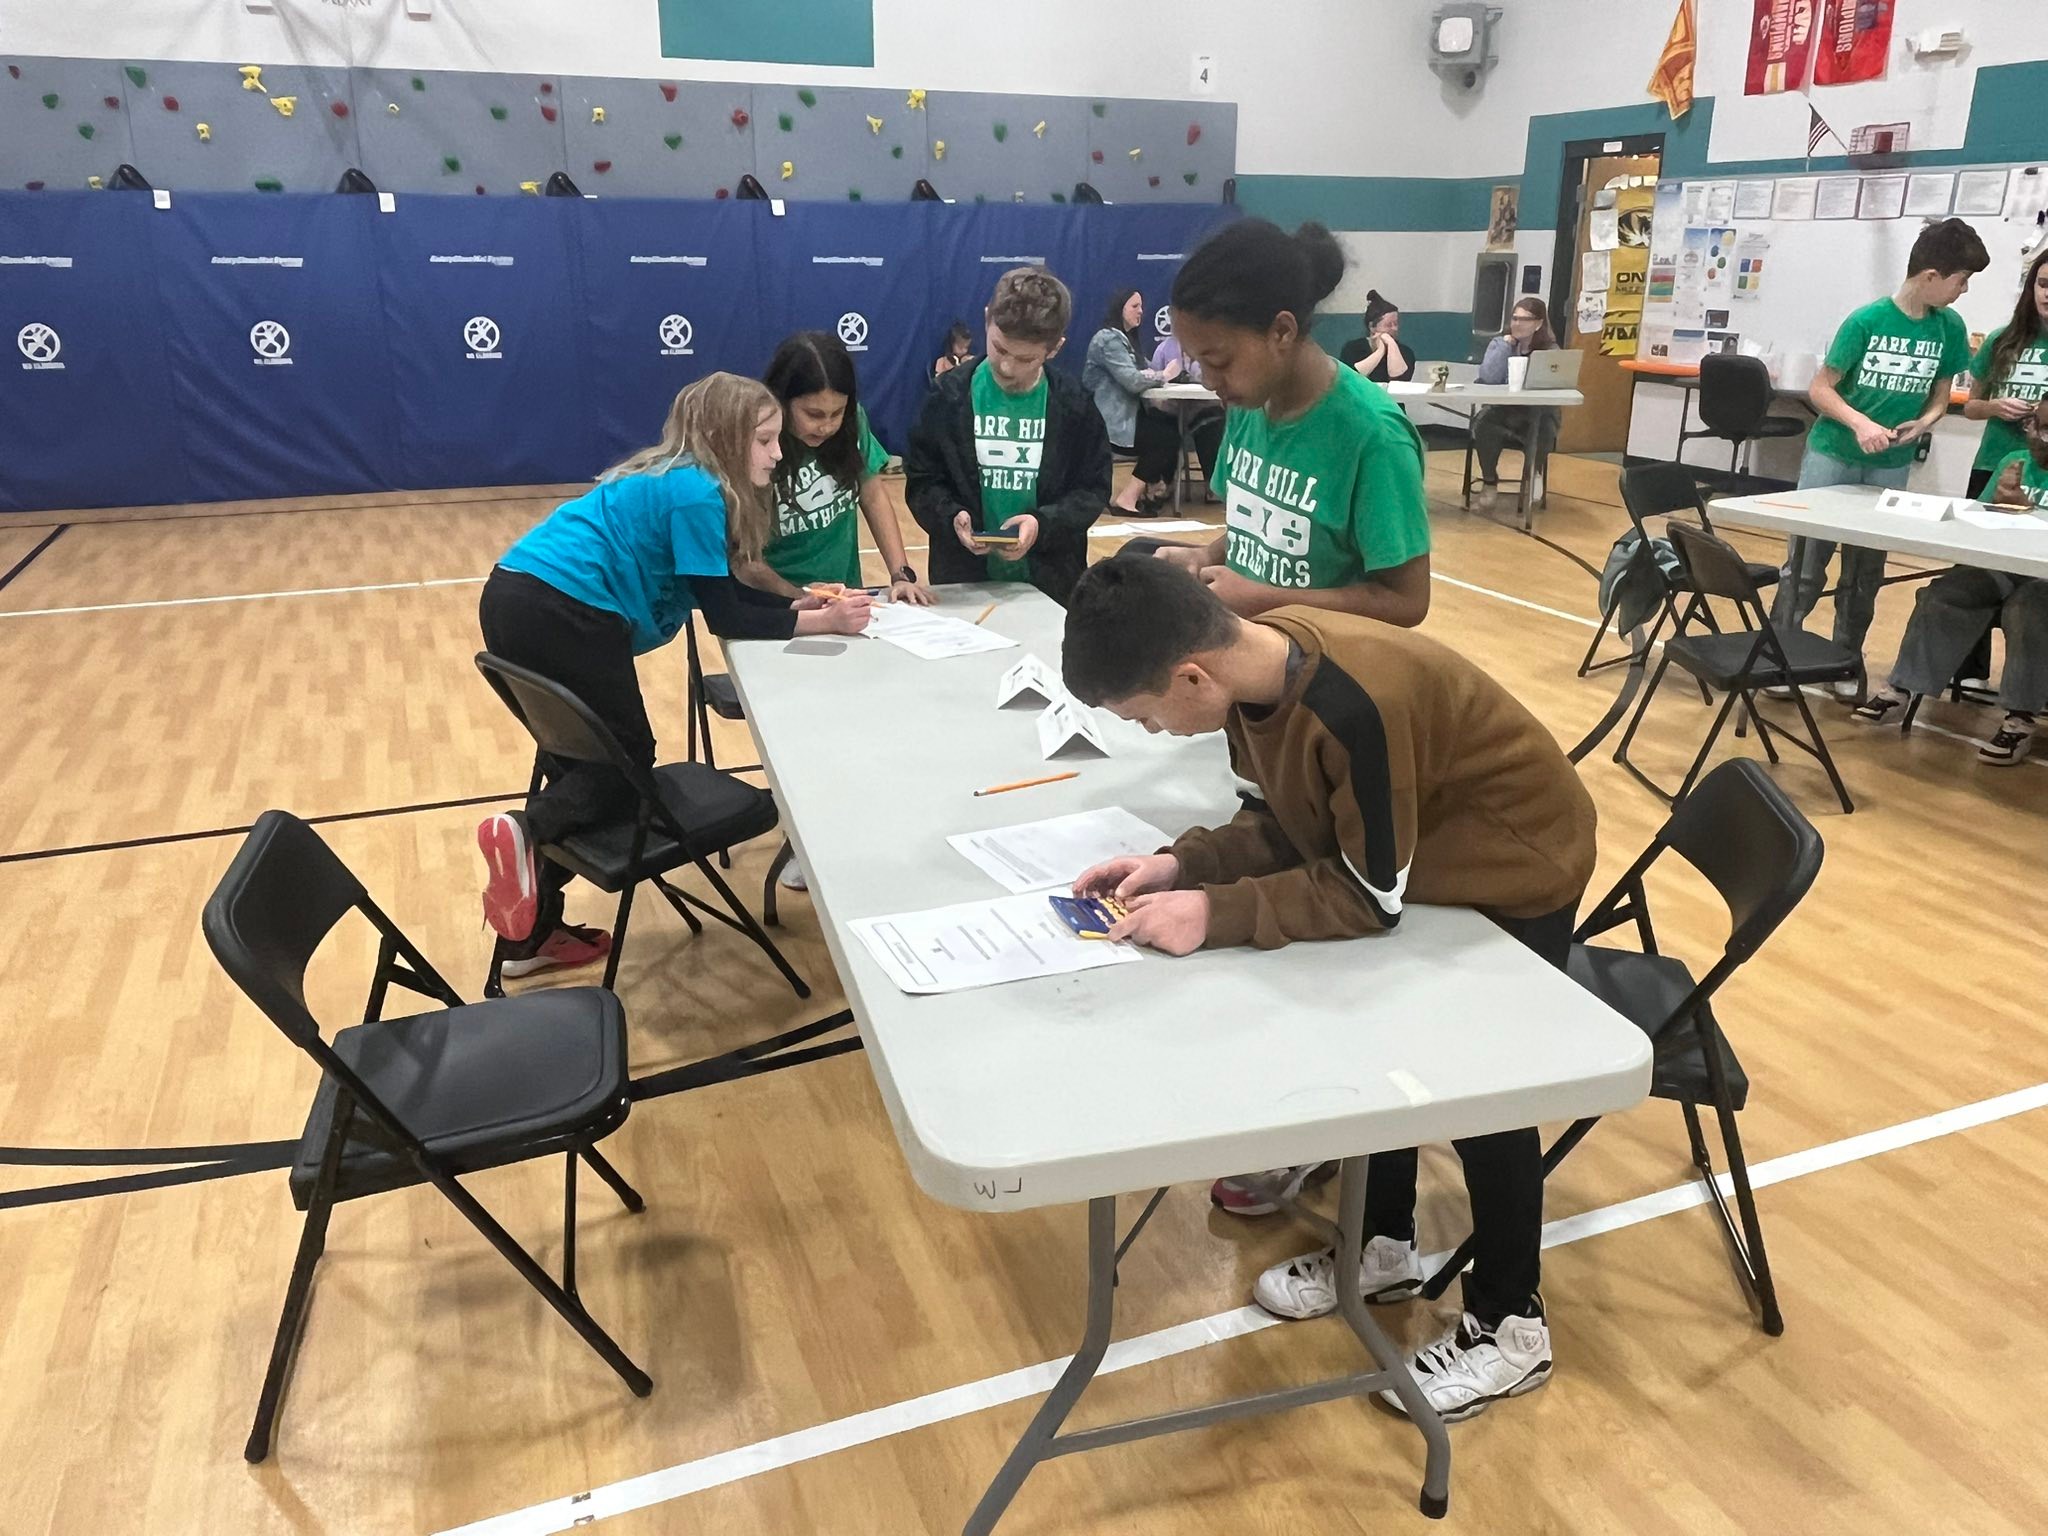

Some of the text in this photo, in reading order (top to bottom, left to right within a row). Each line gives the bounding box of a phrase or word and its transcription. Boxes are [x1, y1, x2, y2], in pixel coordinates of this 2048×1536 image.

[1200, 68, 1208, 84] 4
[1867, 335, 1944, 358] PARK HILL
[973, 414, 1010, 437] ARK
[1265, 463, 1318, 513] HILL
